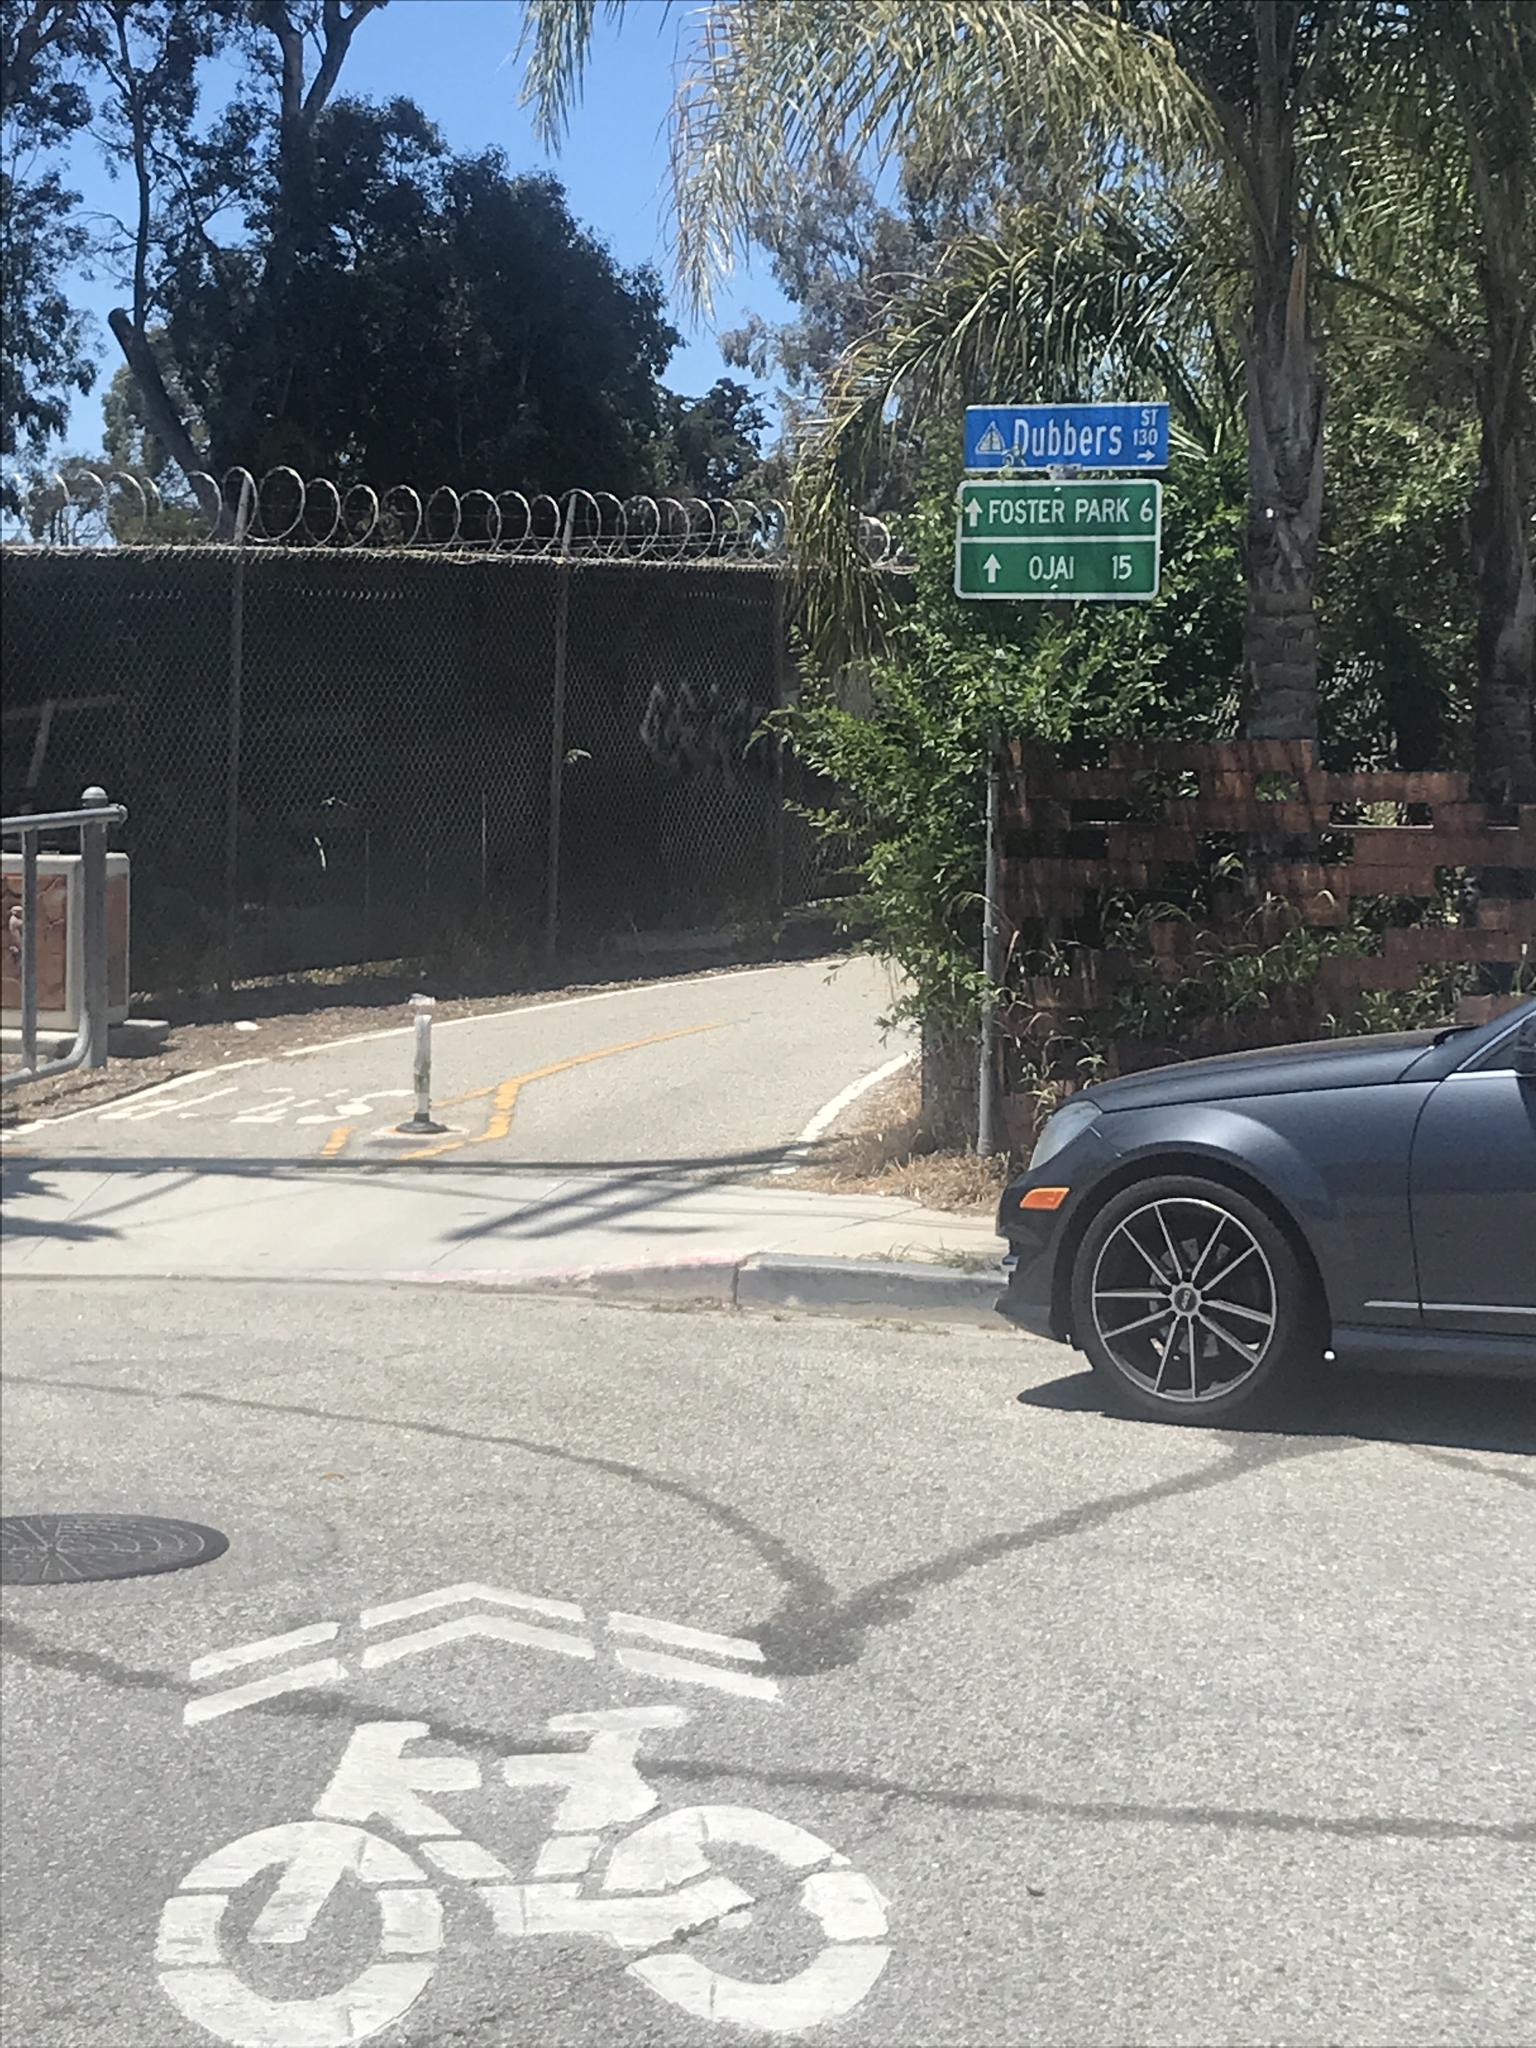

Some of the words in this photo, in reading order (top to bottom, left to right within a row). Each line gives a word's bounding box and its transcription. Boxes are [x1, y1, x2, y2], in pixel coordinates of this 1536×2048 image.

[1015, 419, 1122, 456] Dubbers
[1141, 409, 1159, 426] ST
[1133, 428, 1158, 445] 130
[989, 499, 1064, 523] FOSTER
[1075, 498, 1129, 522] PARK
[1140, 498, 1153, 522] 6
[1029, 556, 1074, 580] OJAI
[1112, 555, 1132, 579] 15
